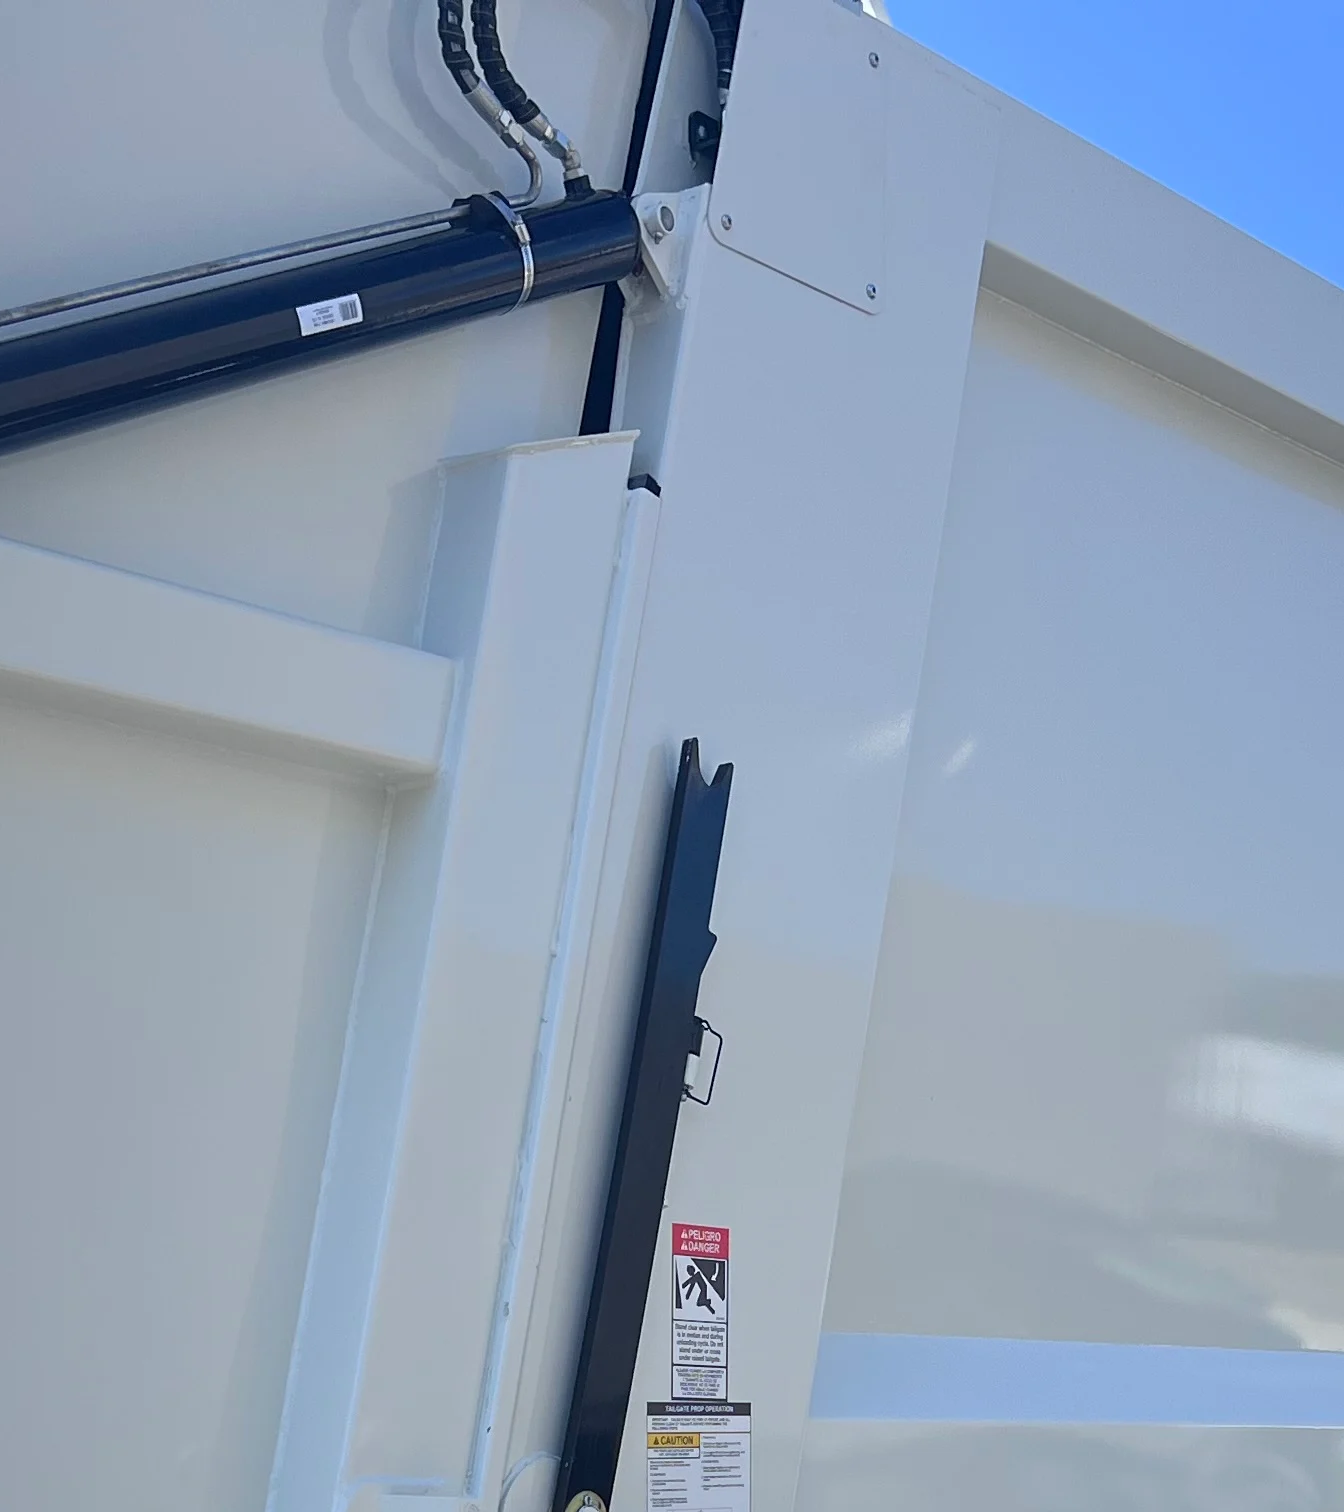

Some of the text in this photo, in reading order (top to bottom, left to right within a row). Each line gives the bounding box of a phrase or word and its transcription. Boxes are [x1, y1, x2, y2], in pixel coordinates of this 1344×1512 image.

[688, 1229, 721, 1242] PELIGRO
[688, 1241, 720, 1253] DANGER
[660, 1436, 694, 1445] CAUTION
